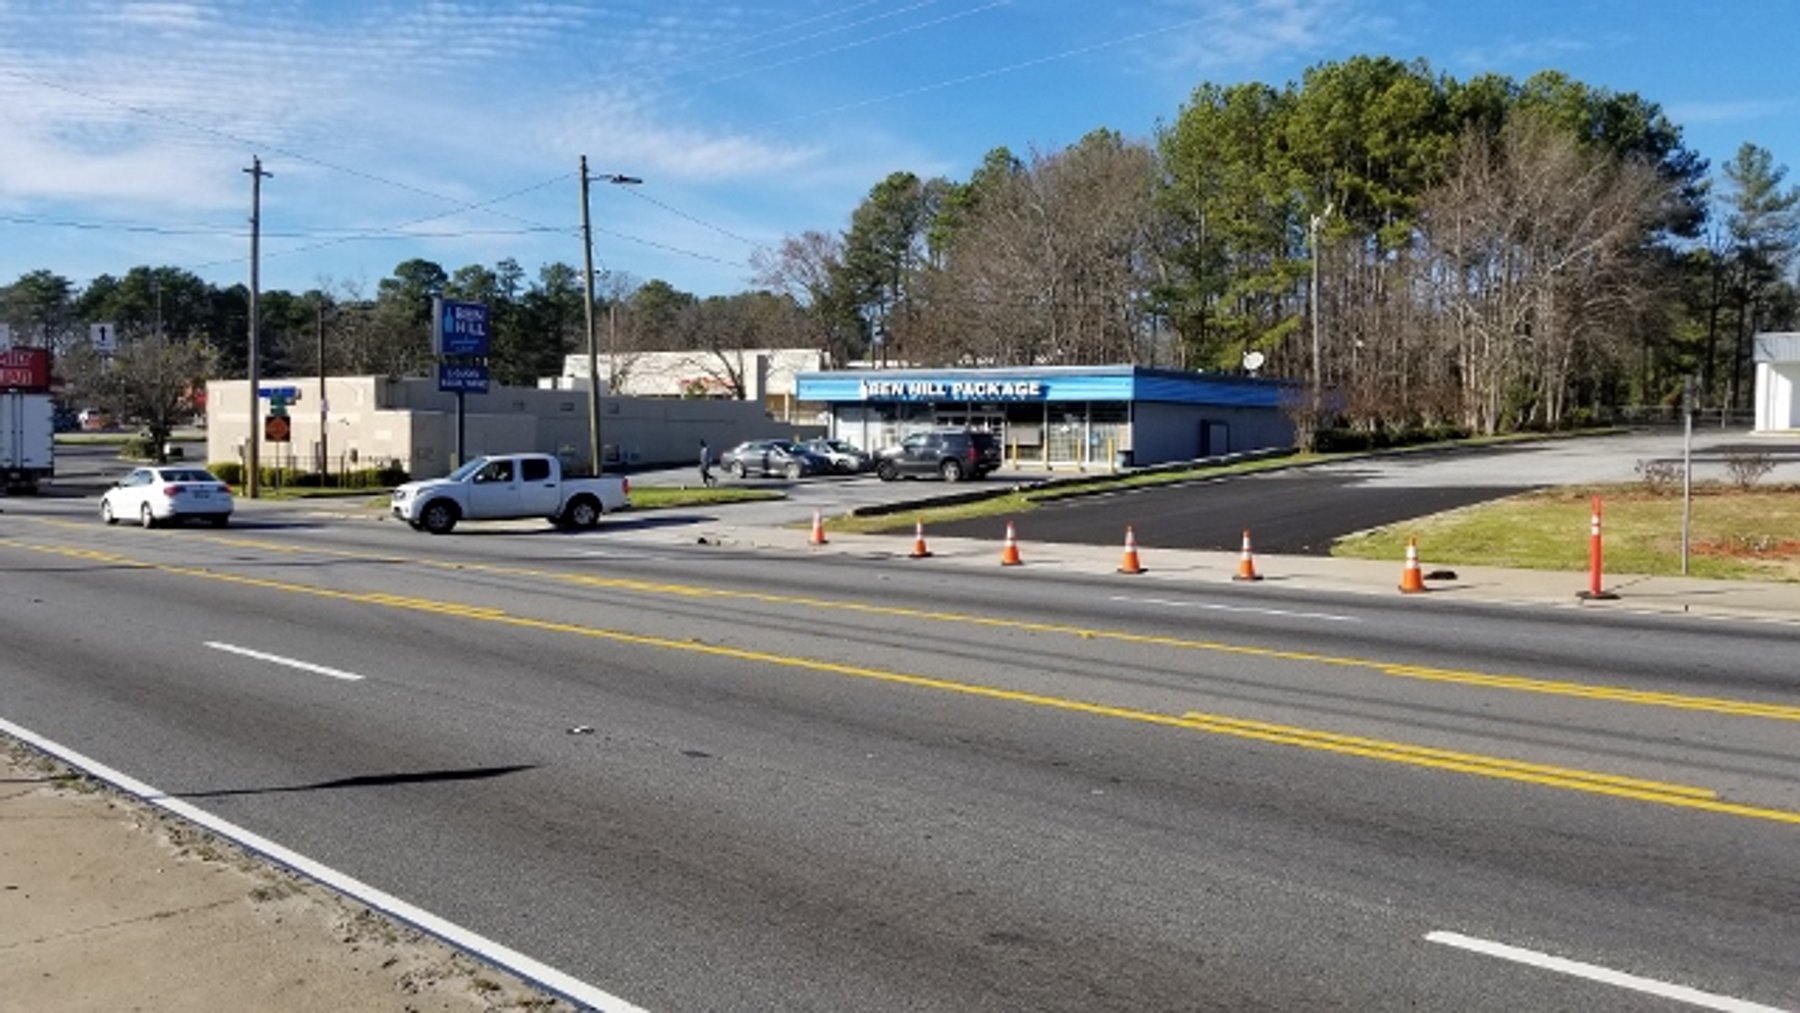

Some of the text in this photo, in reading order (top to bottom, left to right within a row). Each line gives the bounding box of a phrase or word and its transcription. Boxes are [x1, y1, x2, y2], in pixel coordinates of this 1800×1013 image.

[455, 321, 485, 336] HILL
[868, 381, 1041, 396] BEN HILL PACKAGE
